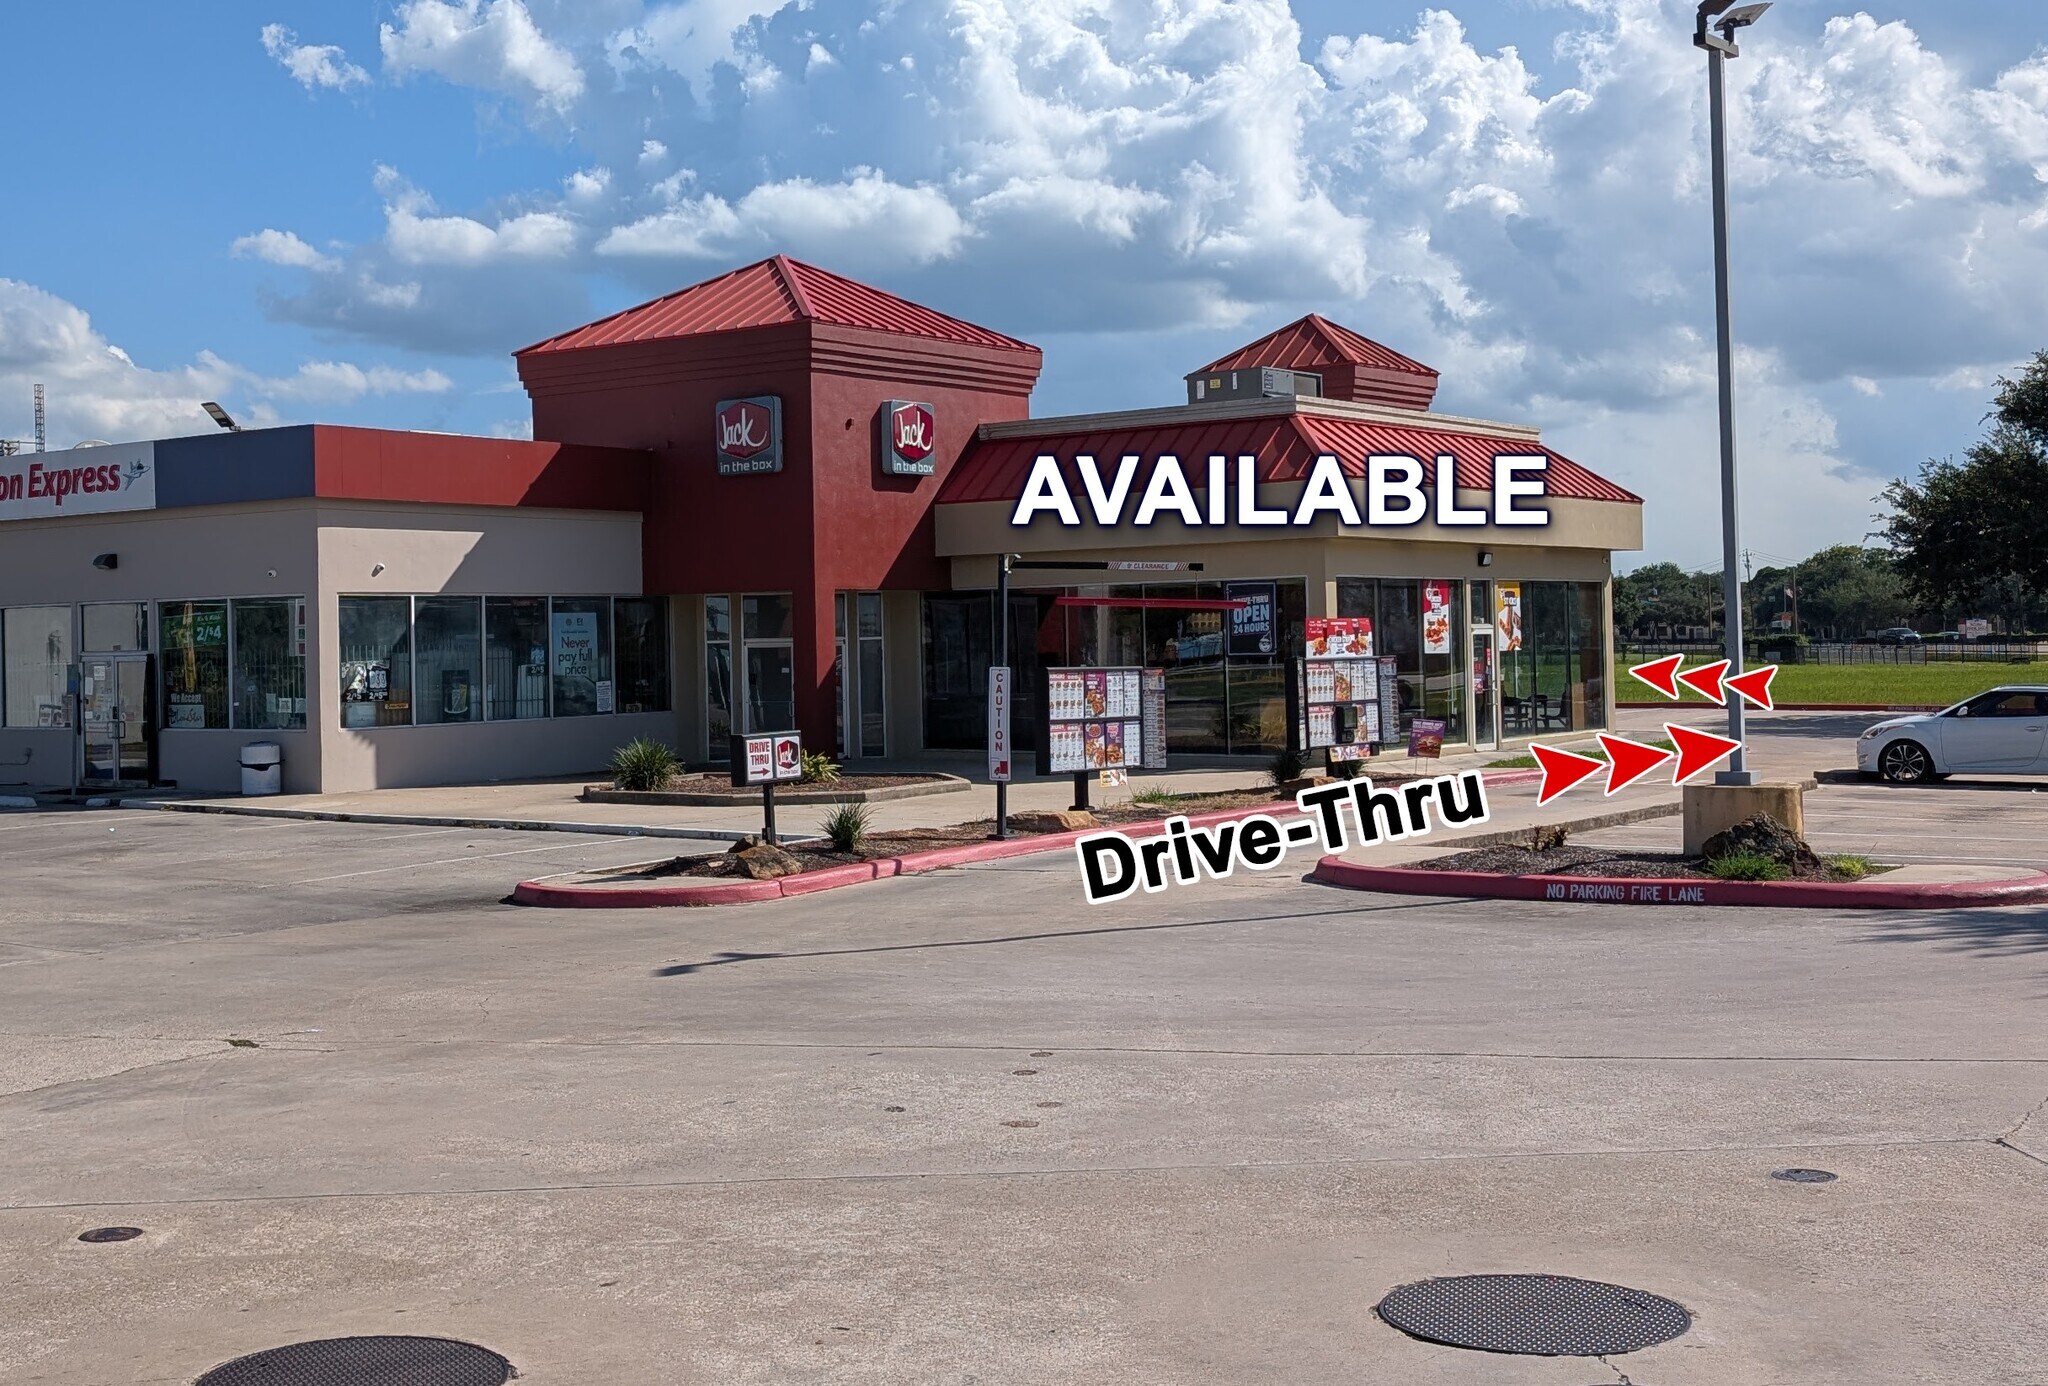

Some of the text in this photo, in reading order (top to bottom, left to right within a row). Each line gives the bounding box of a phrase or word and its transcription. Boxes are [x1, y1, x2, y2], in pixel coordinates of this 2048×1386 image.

[720, 408, 767, 449] Jack
[896, 411, 933, 451] Jack
[720, 460, 773, 473] in the box
[894, 460, 935, 473] in the box
[28, 463, 121, 506] Express
[1133, 562, 1170, 570] CLEARANCE
[1233, 604, 1270, 624] OPEN
[1233, 621, 1270, 634] 24 HOURS
[561, 636, 589, 649] Never
[558, 647, 593, 666] pay full
[564, 662, 587, 678] price
[994, 672, 1004, 752] CAUTION
[749, 741, 770, 753] DRIVE
[750, 754, 770, 766] THRU
[1546, 883, 1706, 902] NO PARKING FIRE LANE
